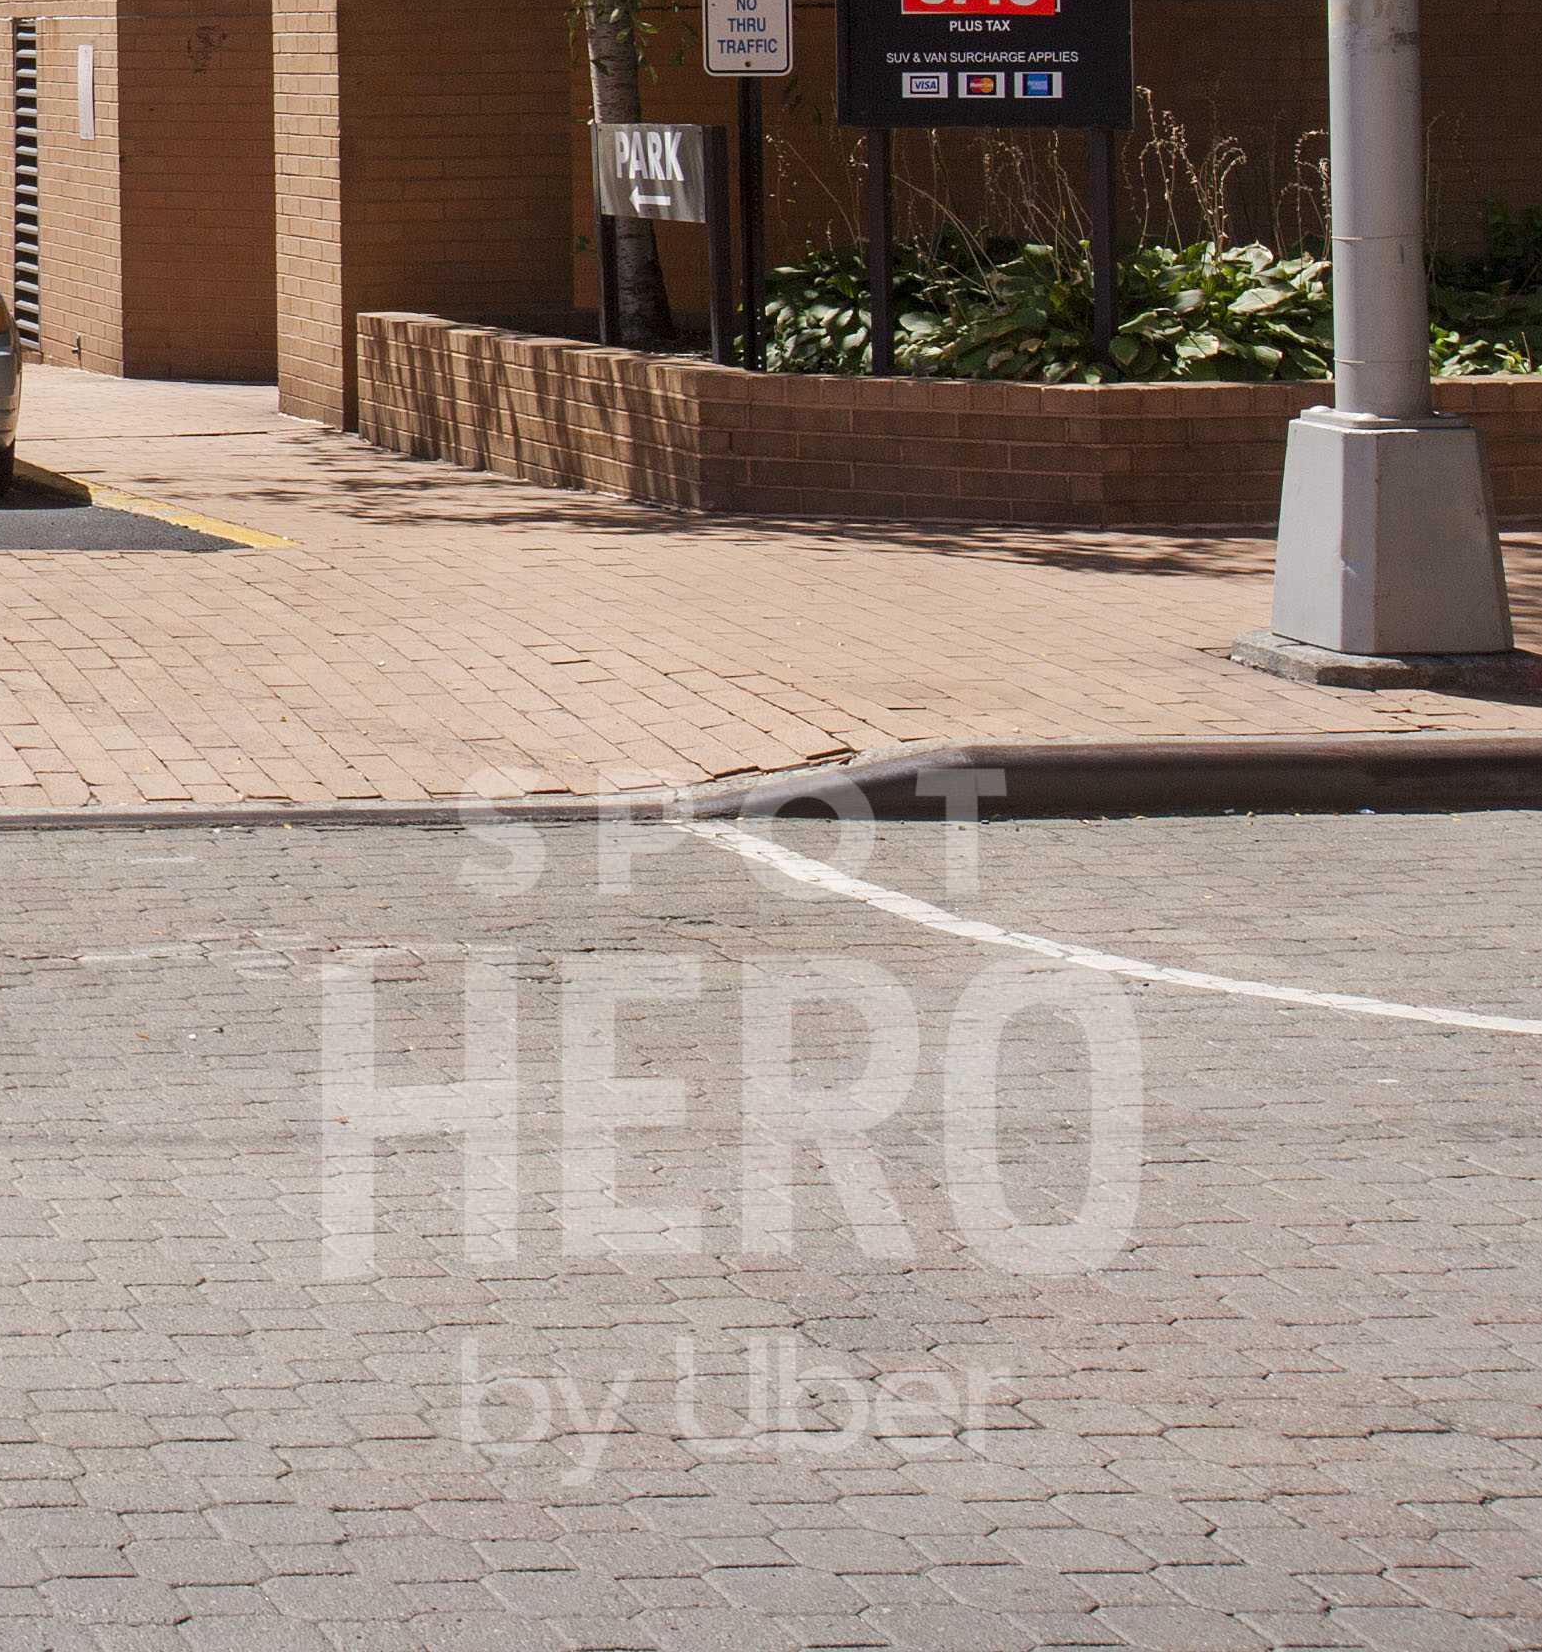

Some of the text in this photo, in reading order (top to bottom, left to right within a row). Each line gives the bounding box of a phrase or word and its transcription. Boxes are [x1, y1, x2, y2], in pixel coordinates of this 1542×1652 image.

[727, 17, 766, 33] THRU
[949, 19, 1011, 32] PLUS TAX
[717, 38, 778, 55] TRAFFIC
[886, 51, 1079, 64] SUV & VAN SURCHARGE APPLIES
[914, 81, 937, 90] VISA
[615, 131, 685, 181] PARK
